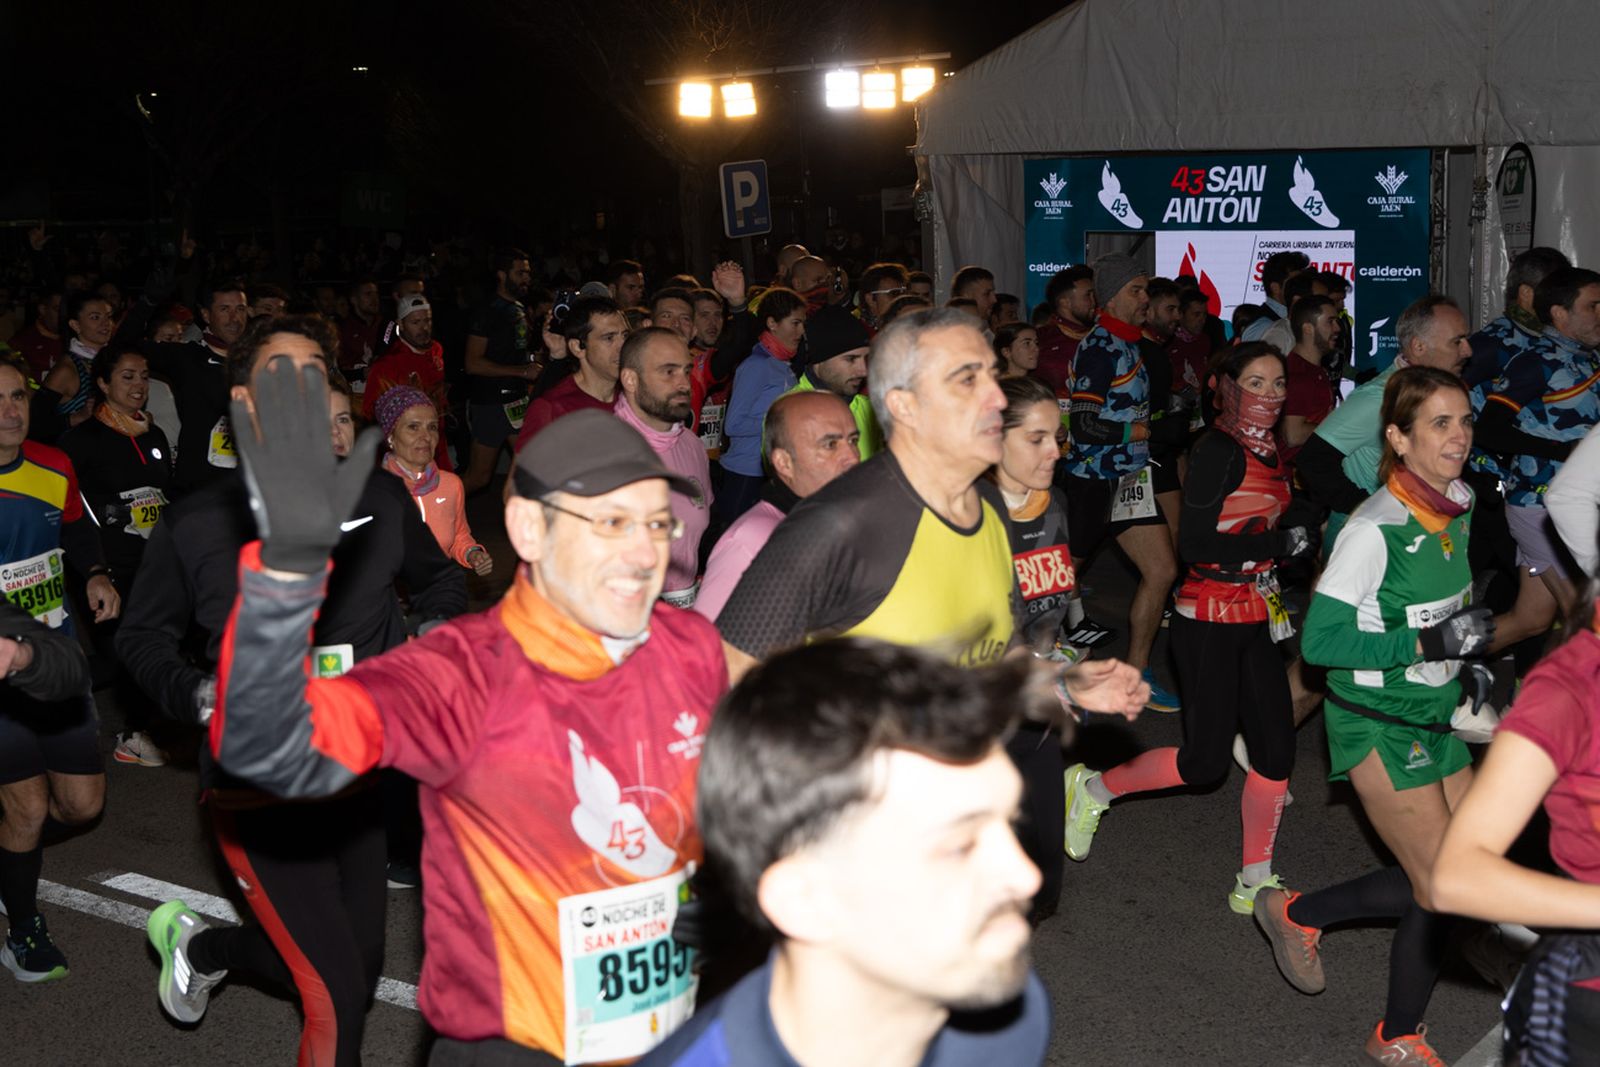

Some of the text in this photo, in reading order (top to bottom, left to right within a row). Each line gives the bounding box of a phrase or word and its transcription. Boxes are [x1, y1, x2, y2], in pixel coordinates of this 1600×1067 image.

[731, 170, 760, 228] P
[1111, 198, 1129, 218] 43
[1162, 187, 1261, 223] ANTÓN
[1303, 195, 1323, 217] 43
[1366, 196, 1416, 205] CAJA RURAL
[1258, 241, 1292, 249] CARRERA
[1292, 241, 1323, 249] URBANA
[1359, 265, 1422, 277] calderón
[13, 566, 37, 579] NOCHE
[5, 579, 23, 591] SAN
[10, 576, 64, 610] 13916
[607, 820, 647, 860] 43
[603, 906, 648, 925] NOCHE
[652, 898, 667, 916] DE
[585, 933, 616, 953] SAN
[598, 938, 688, 1002] 8595
